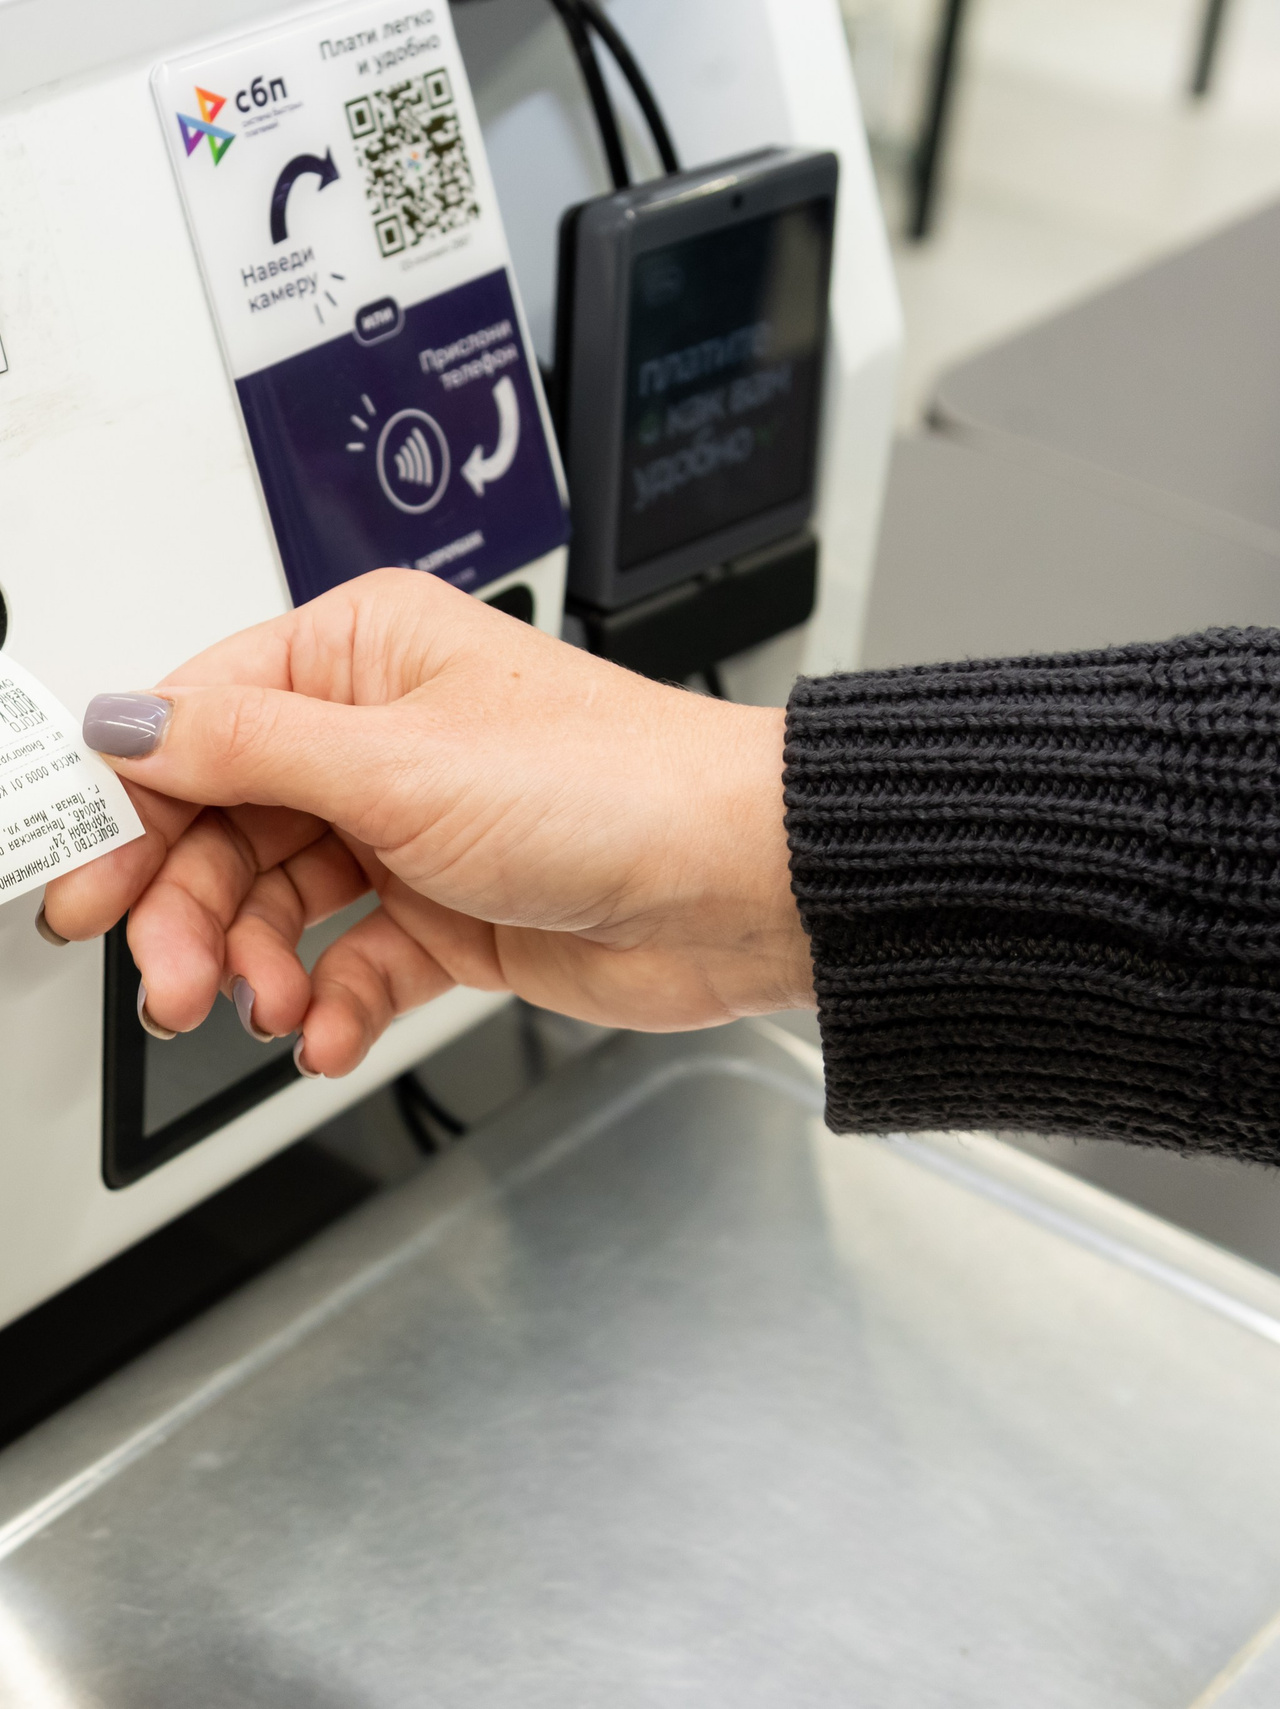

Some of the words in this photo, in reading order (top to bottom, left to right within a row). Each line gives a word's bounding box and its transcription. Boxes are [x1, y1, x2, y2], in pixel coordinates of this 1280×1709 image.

[319, 28, 378, 61] Плати
[382, 9, 435, 38] легко
[357, 58, 370, 76] и
[375, 32, 441, 76] удобно
[241, 246, 315, 287] Наведи
[248, 272, 319, 314] камеру
[439, 343, 519, 391] телефон
[9, 710, 49, 733] ИТОГО
[10, 765, 49, 791] 0009.01
[50, 751, 81, 772] КАССА
[7, 817, 66, 851] Пензенская
[23, 810, 49, 828] Мира
[74, 821, 120, 853] ОБЩЕСТВО
[65, 849, 72, 859] С
